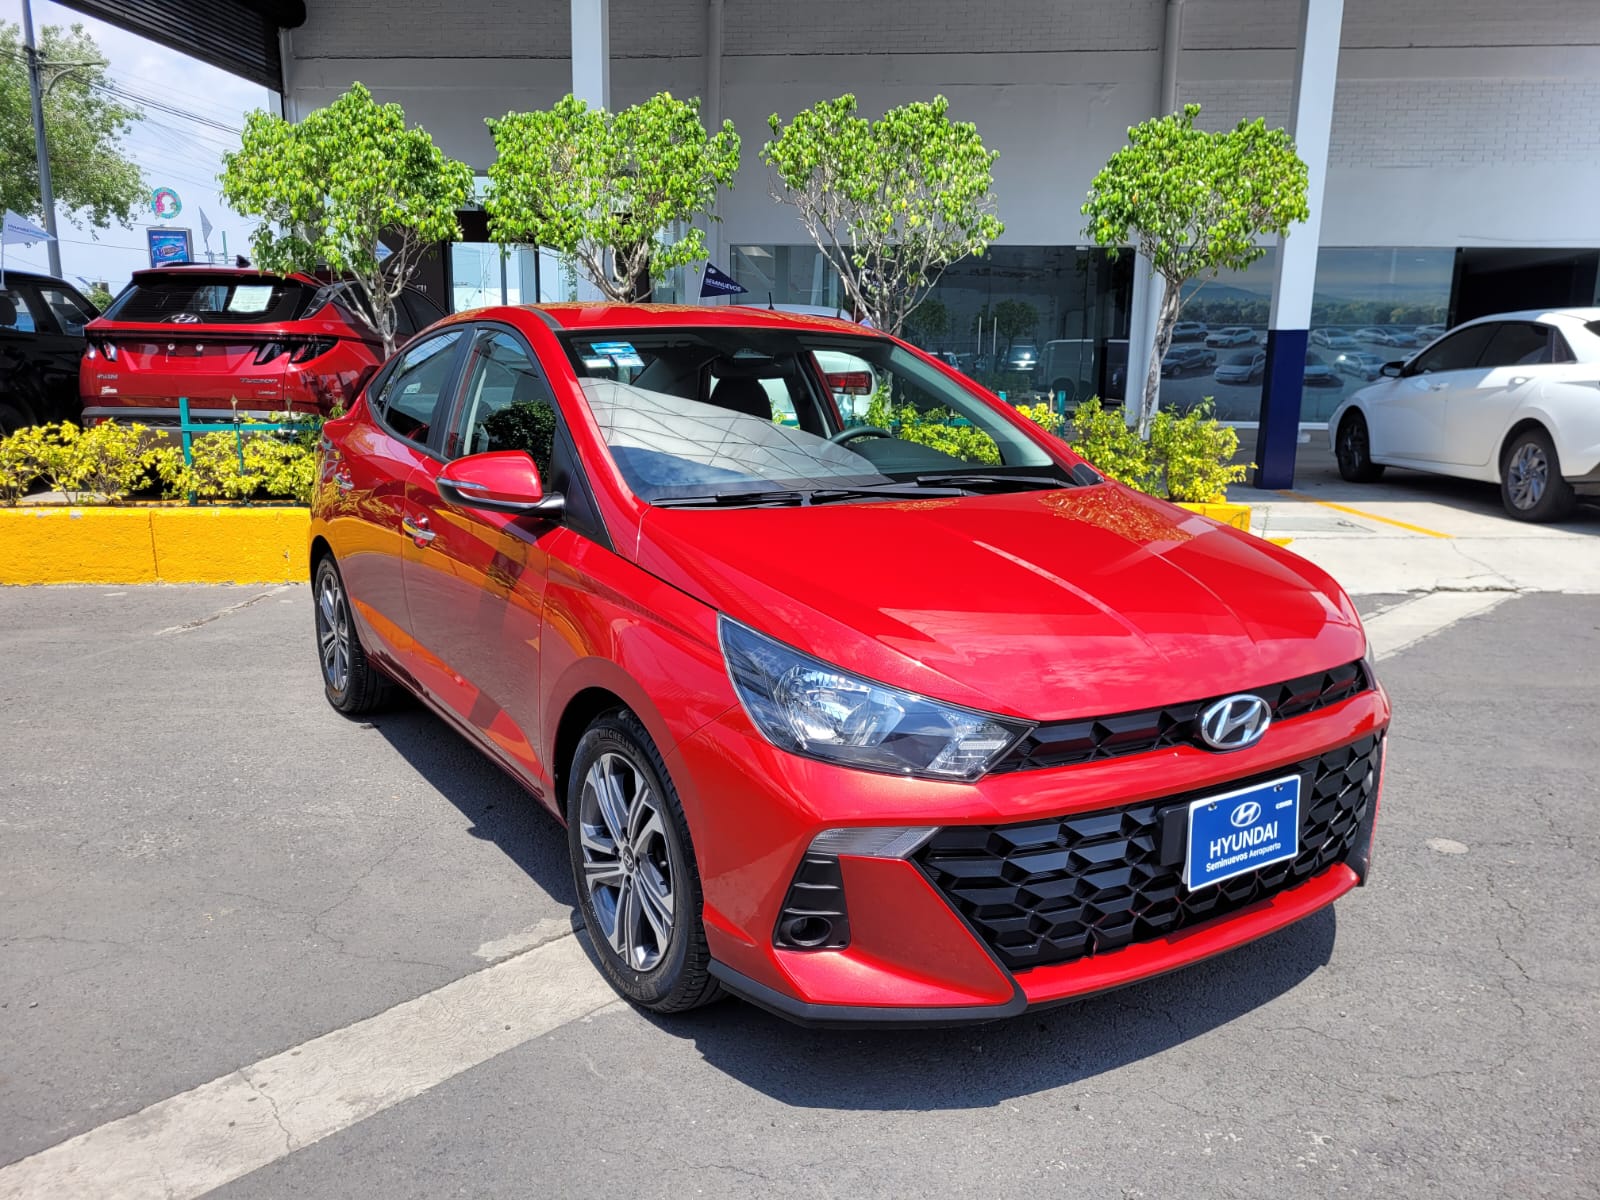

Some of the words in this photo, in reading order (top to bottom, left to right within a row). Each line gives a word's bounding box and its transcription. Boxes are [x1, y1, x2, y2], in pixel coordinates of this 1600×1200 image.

[1205, 851, 1249, 872] Seminuevos
[1248, 842, 1281, 858] Aeropuerto
[1209, 820, 1278, 860] HYUNDAI
